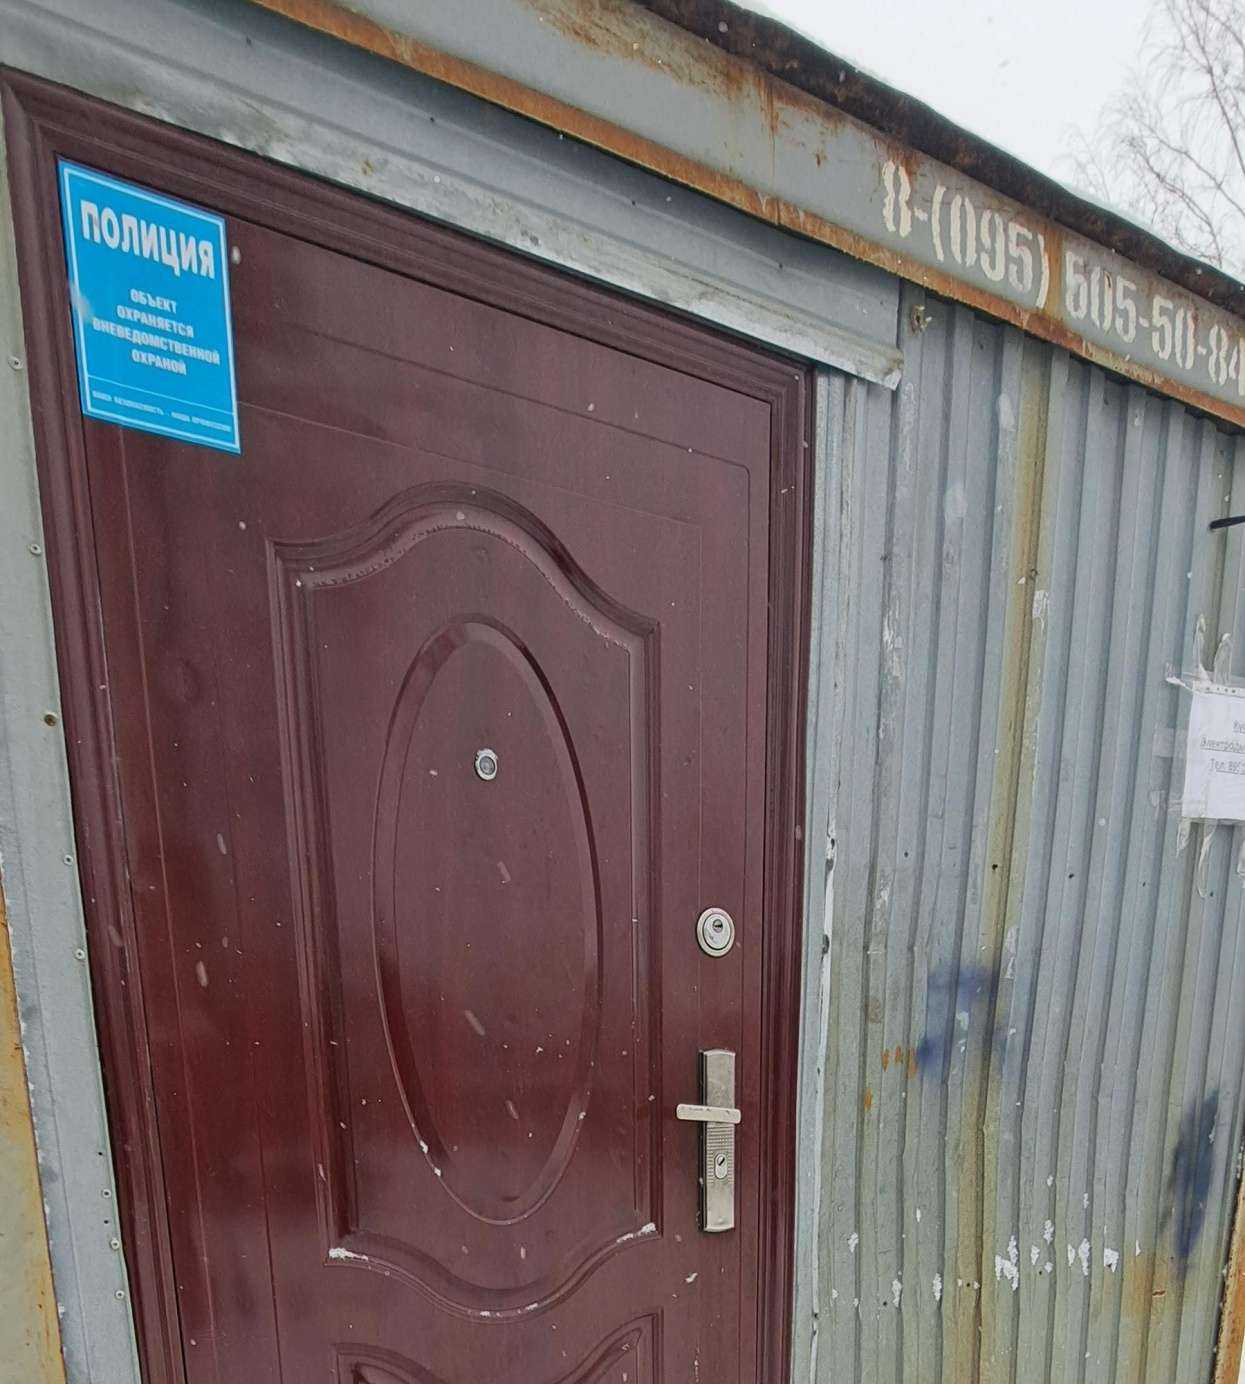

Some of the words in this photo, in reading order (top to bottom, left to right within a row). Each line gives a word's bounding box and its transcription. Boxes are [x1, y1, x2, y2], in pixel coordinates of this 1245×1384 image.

[80, 199, 215, 279] ПОЛИЦИЯ
[883, 160, 1049, 309] 8-(095)
[116, 304, 194, 338] ОХРАНЯЕТСЯ
[130, 288, 177, 314] ОБЪЕКТ
[92, 317, 220, 365] ВНЕВЕДОМСТВЕННОЙ
[131, 349, 187, 376] ОХРАНОЙ
